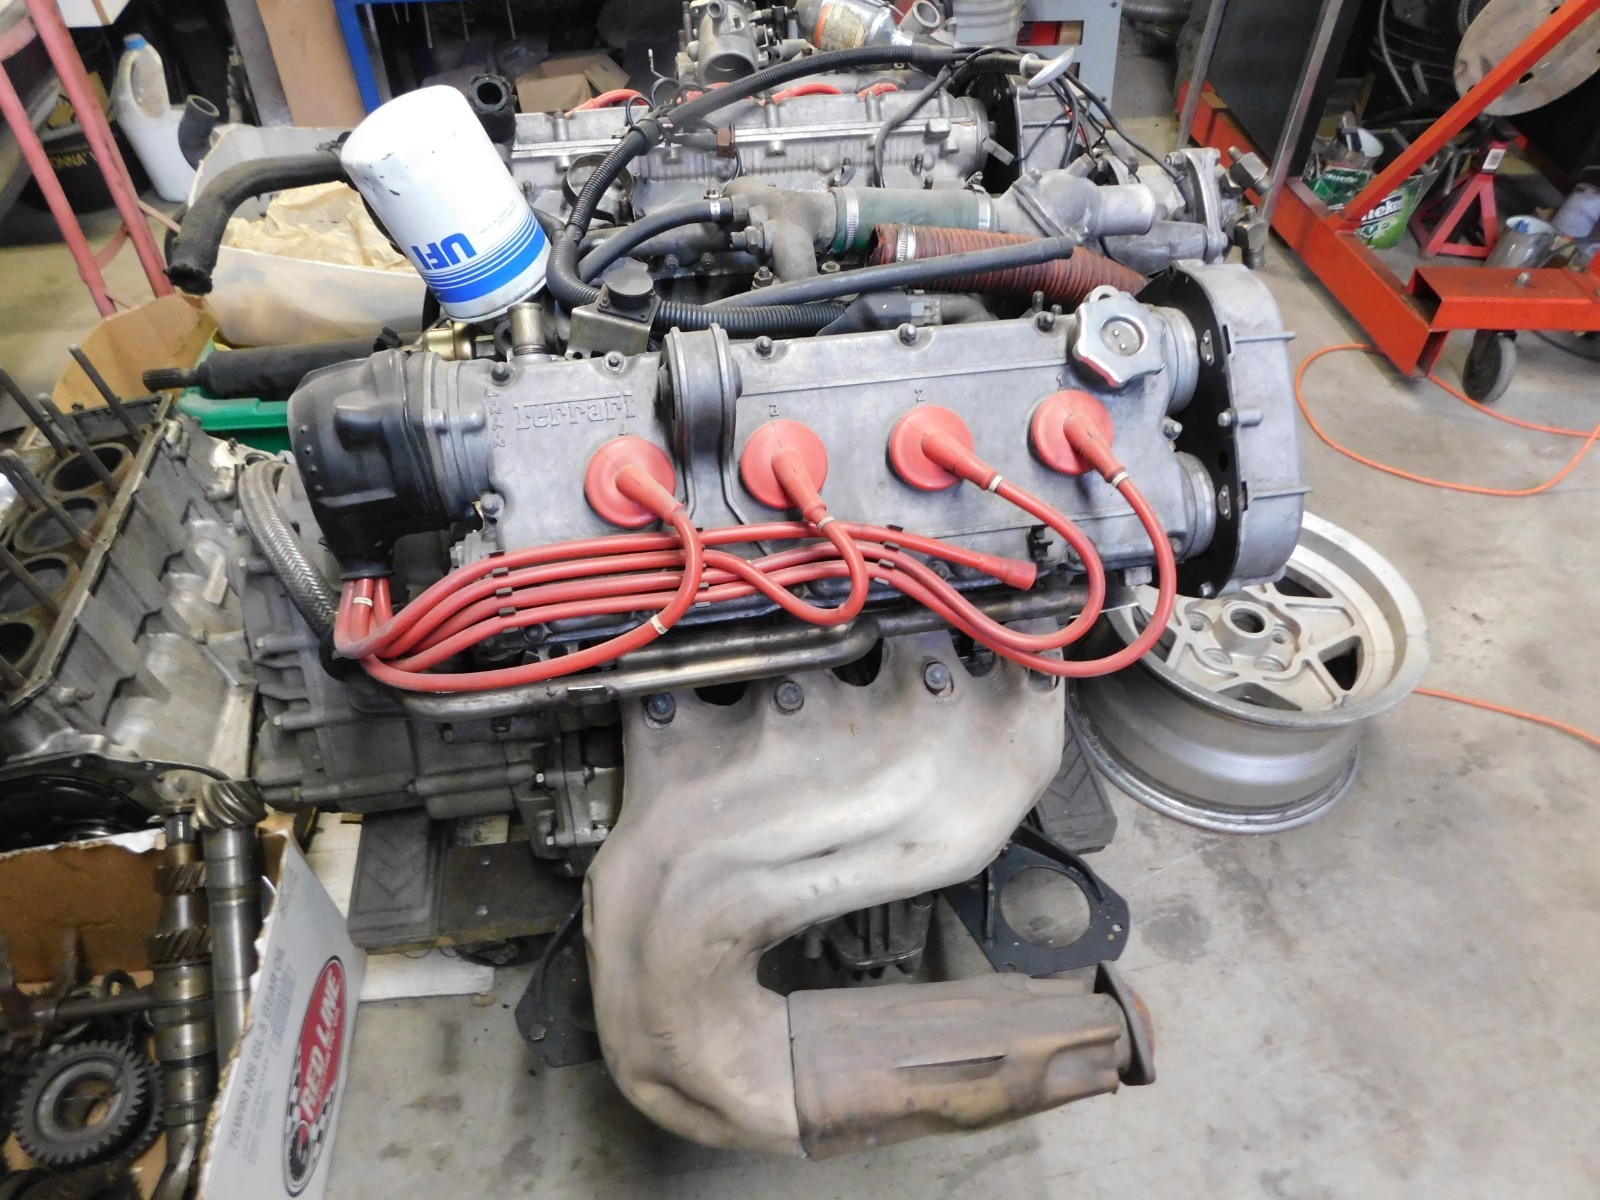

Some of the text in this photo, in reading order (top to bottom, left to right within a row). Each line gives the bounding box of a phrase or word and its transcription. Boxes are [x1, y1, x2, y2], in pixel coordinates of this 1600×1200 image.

[411, 232, 477, 270] UFI
[513, 390, 635, 431] Ferrari
[768, 403, 780, 418] 3
[914, 388, 926, 403] 2
[244, 1061, 258, 1089] NS
[252, 1021, 268, 1059] GL-5
[263, 972, 280, 1018] GEAR
[274, 947, 286, 971] OIL
[301, 968, 341, 1121] RED LINE
